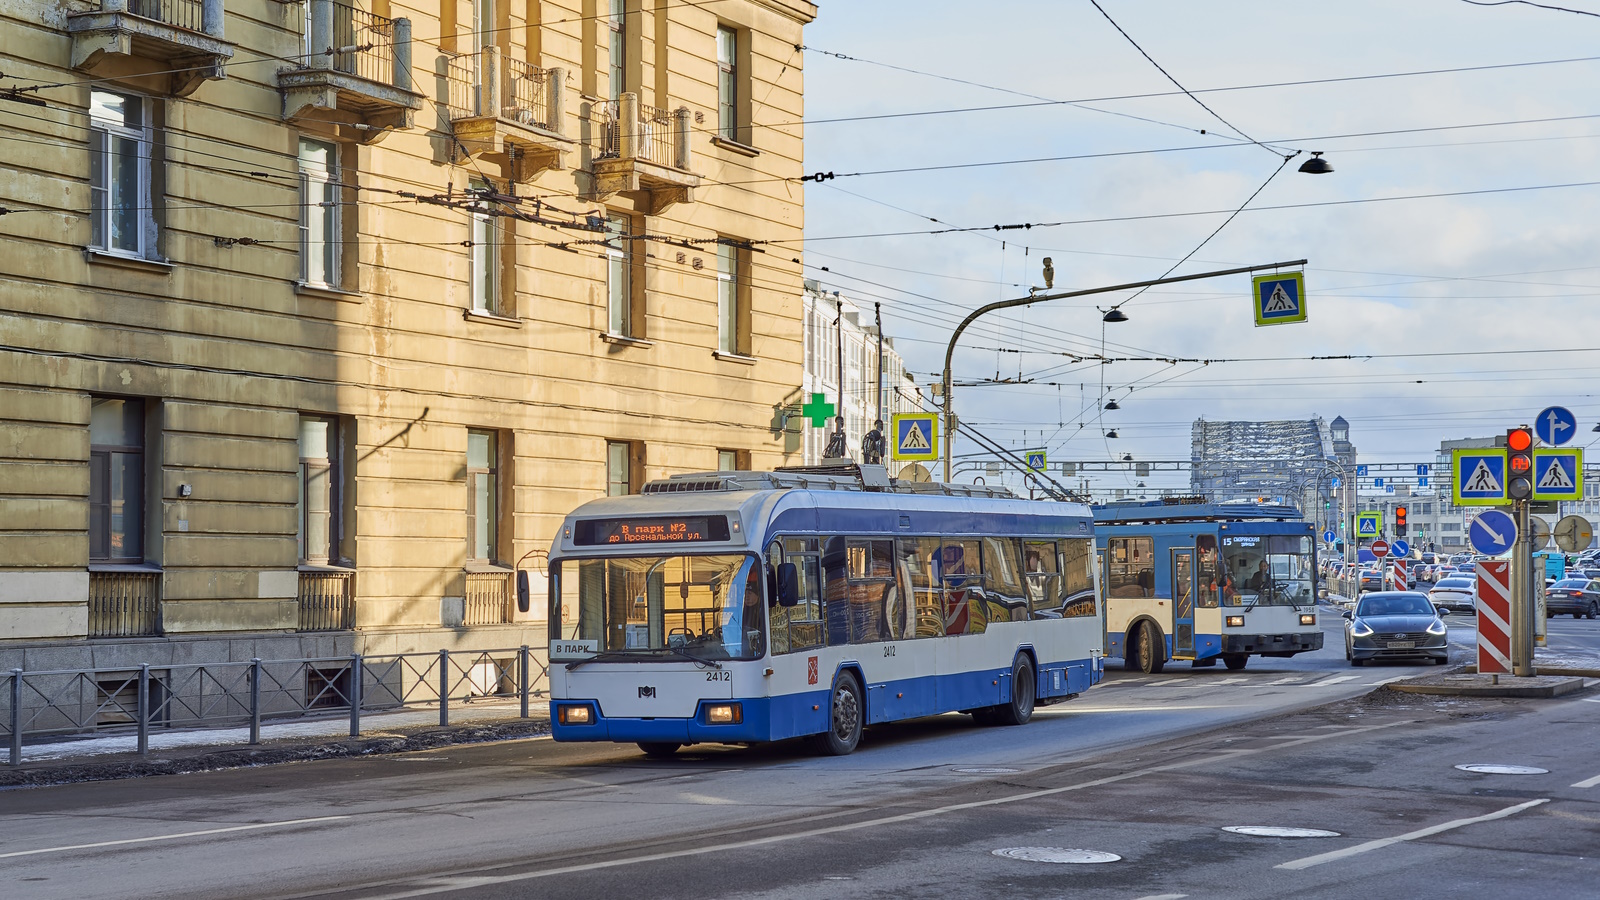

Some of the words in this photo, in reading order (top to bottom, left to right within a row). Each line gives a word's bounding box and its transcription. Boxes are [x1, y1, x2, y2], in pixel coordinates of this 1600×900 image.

[621, 524, 629, 534] В
[635, 525, 664, 534] парк
[609, 534, 620, 543] до
[624, 532, 683, 542] Арсенальной
[687, 532, 702, 540] ул.
[1223, 537, 1232, 546] 15
[556, 644, 562, 653] В
[564, 644, 590, 653] ПАРК
[883, 645, 896, 658] 2412
[706, 671, 730, 682] 2412
